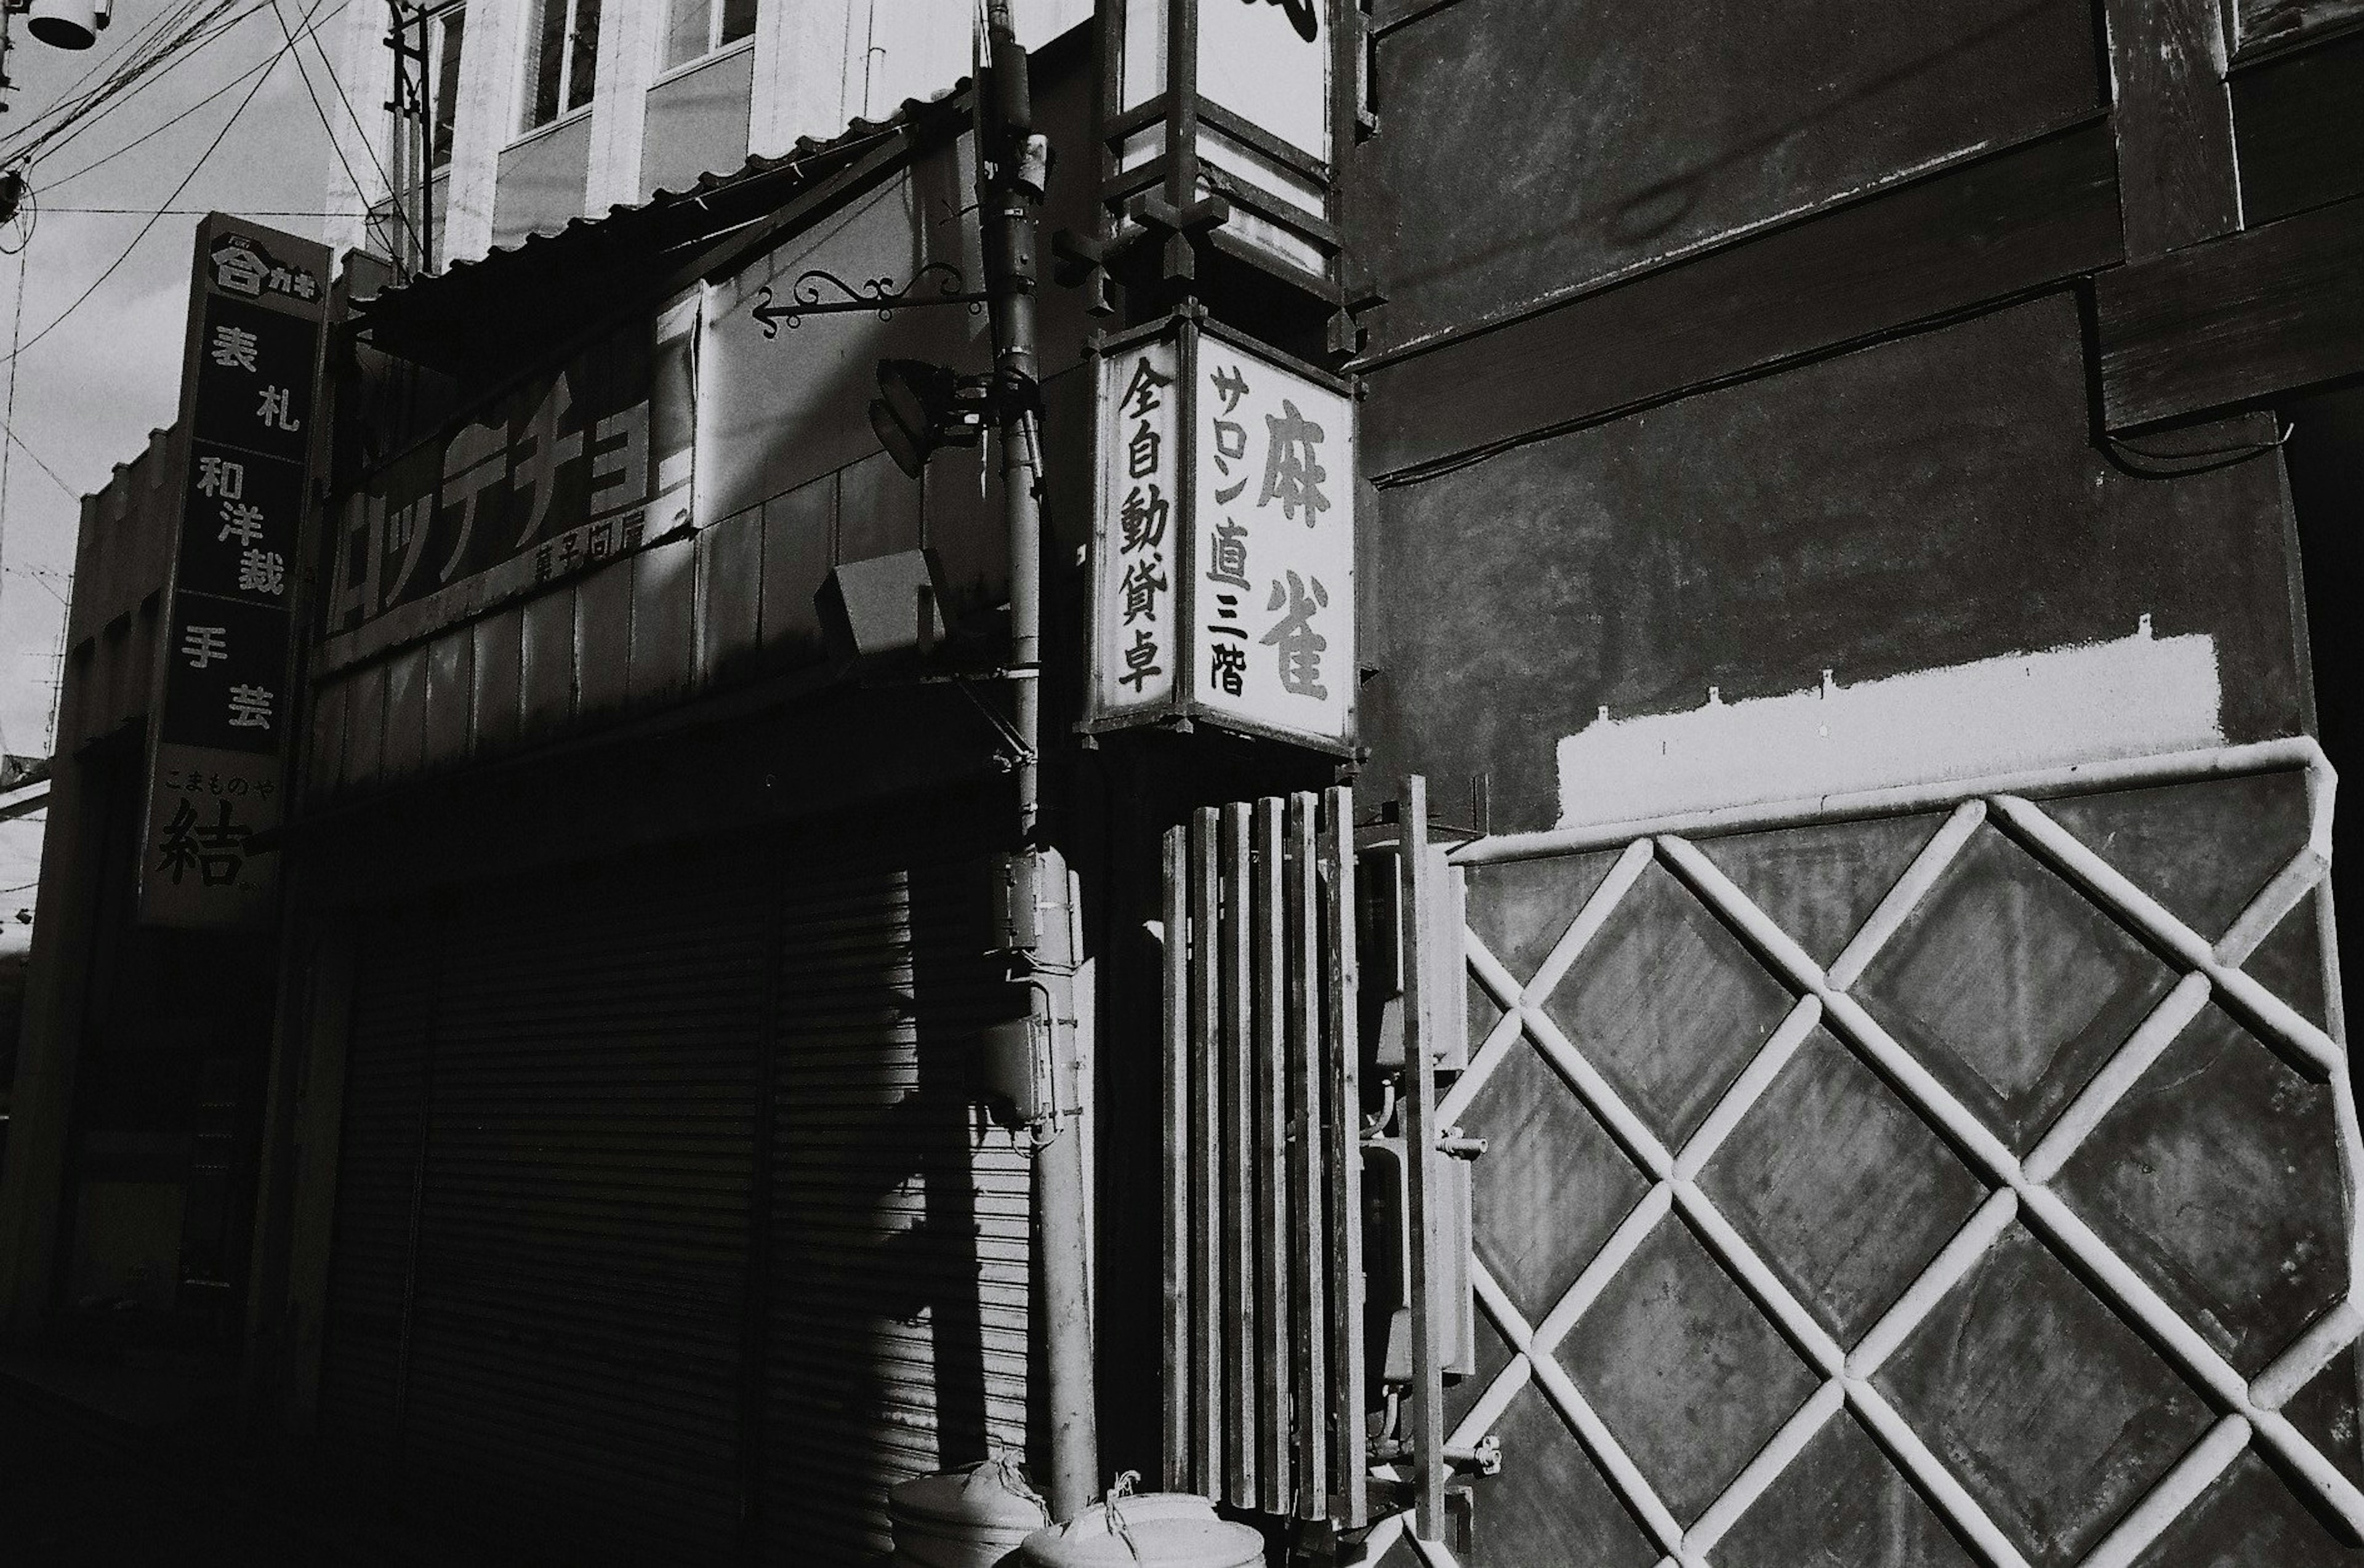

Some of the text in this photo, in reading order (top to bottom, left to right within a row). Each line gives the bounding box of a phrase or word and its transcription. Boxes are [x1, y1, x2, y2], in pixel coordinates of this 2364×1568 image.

[211, 326, 300, 432] 表札
[196, 456, 285, 595] 和洋裁
[1119, 357, 1173, 693] 全自動貸卓
[1257, 398, 1330, 702] 麻雀
[181, 624, 274, 730] 手芸
[165, 770, 275, 802] こまものや
[155, 797, 253, 887] 結
